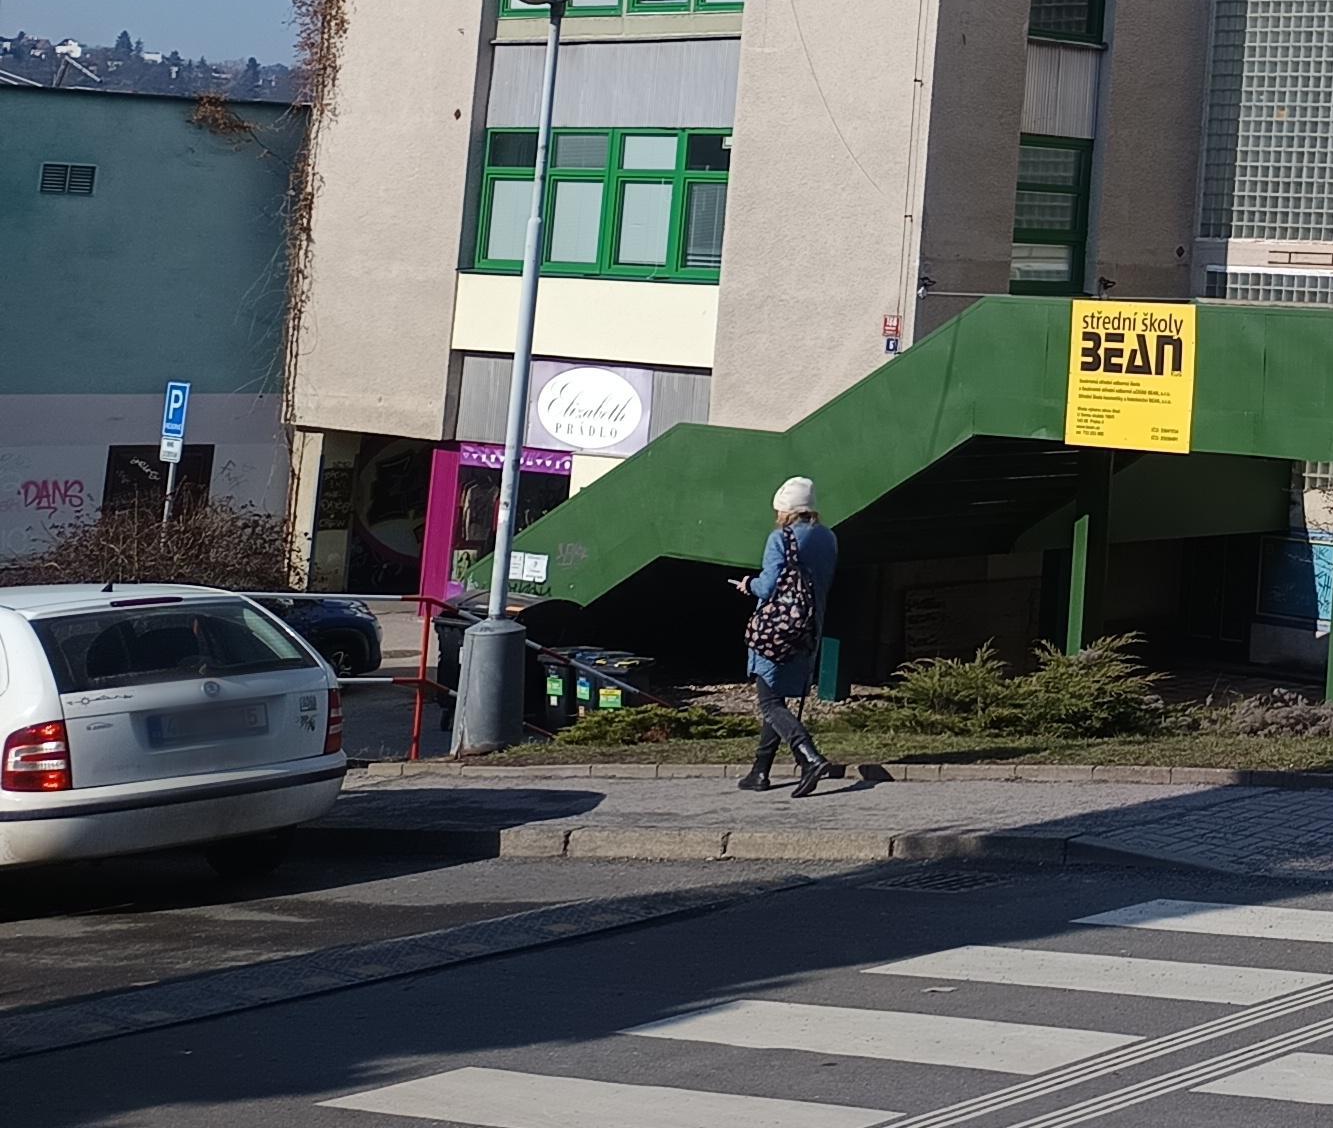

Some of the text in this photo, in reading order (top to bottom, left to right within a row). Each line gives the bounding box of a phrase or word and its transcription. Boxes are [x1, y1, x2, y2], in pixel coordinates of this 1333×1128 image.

[1082, 310, 1184, 336] střední školy
[1080, 331, 1183, 376] BEAN
[168, 389, 183, 420] P
[547, 382, 634, 423] Elizabeth
[555, 421, 618, 439] PRÁDLO
[21, 479, 84, 509] DANS
